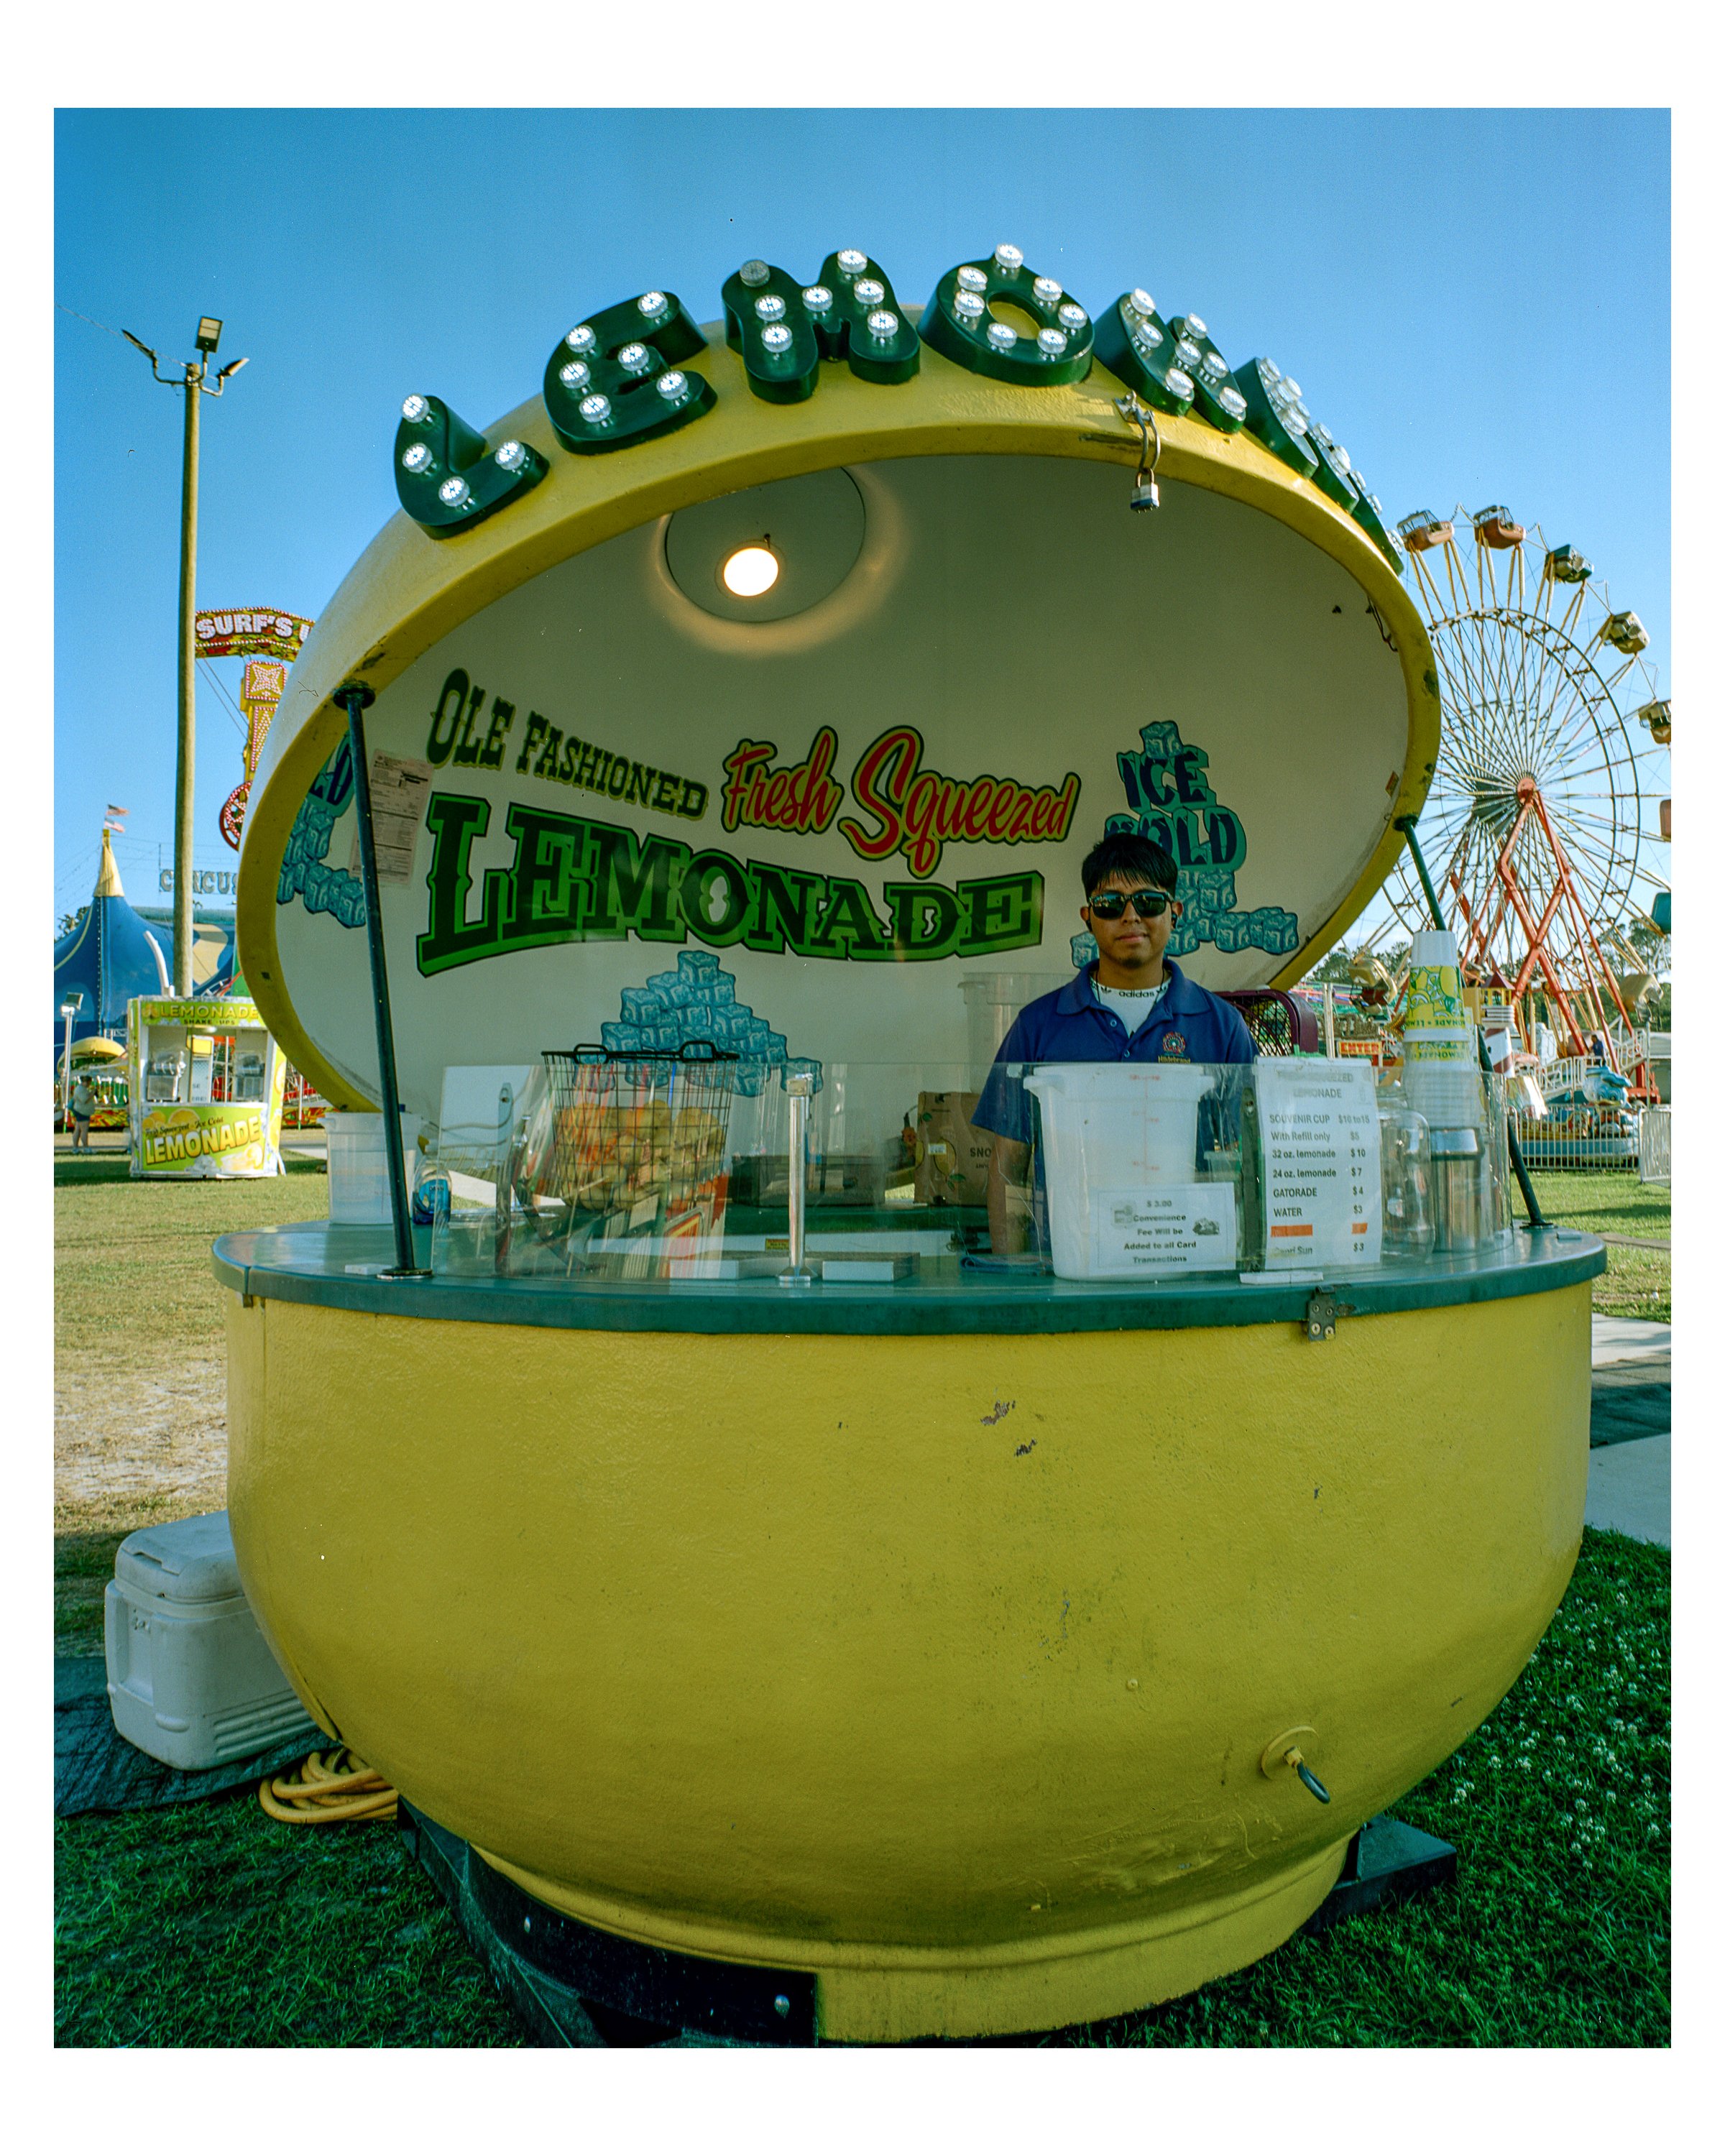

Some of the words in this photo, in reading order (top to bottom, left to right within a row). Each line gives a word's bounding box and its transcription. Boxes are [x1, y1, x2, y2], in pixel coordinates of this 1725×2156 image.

[196, 613, 293, 640] SURF'S
[426, 668, 515, 770] OLE
[516, 709, 710, 821] FASHIONED
[1116, 744, 1218, 815] ICE
[721, 725, 846, 834] Fresh
[838, 725, 1082, 880] Squeezed
[1104, 805, 1247, 872] OLD
[416, 791, 1045, 978] LEMONADE
[1118, 990, 1155, 998] adidas
[160, 1005, 259, 1019] LEMONADE
[1340, 1042, 1379, 1054] ENTER
[1294, 1088, 1342, 1098] LEMONADE
[1269, 1114, 1312, 1124] SOUVENIR
[1314, 1114, 1330, 1124] CUP
[1338, 1114, 1352, 1125] $10
[145, 1115, 261, 1166] LEMONADE
[1271, 1132, 1290, 1141] With
[1292, 1131, 1312, 1141] Refill
[1314, 1131, 1330, 1143] only
[1351, 1131, 1360, 1141] $5
[970, 1147, 992, 1158] SNO
[1272, 1149, 1282, 1158] 32
[1297, 1148, 1336, 1158] lemonade
[1273, 1169, 1282, 1179] 24
[1284, 1170, 1295, 1179] oz.
[1297, 1168, 1337, 1178] lemonade
[1273, 1187, 1317, 1198] GATORADE
[1274, 1207, 1302, 1217] WATER
[1124, 1242, 1150, 1250] Added
[1297, 1245, 1313, 1255] Sun
[1133, 1255, 1187, 1264] Transactions
